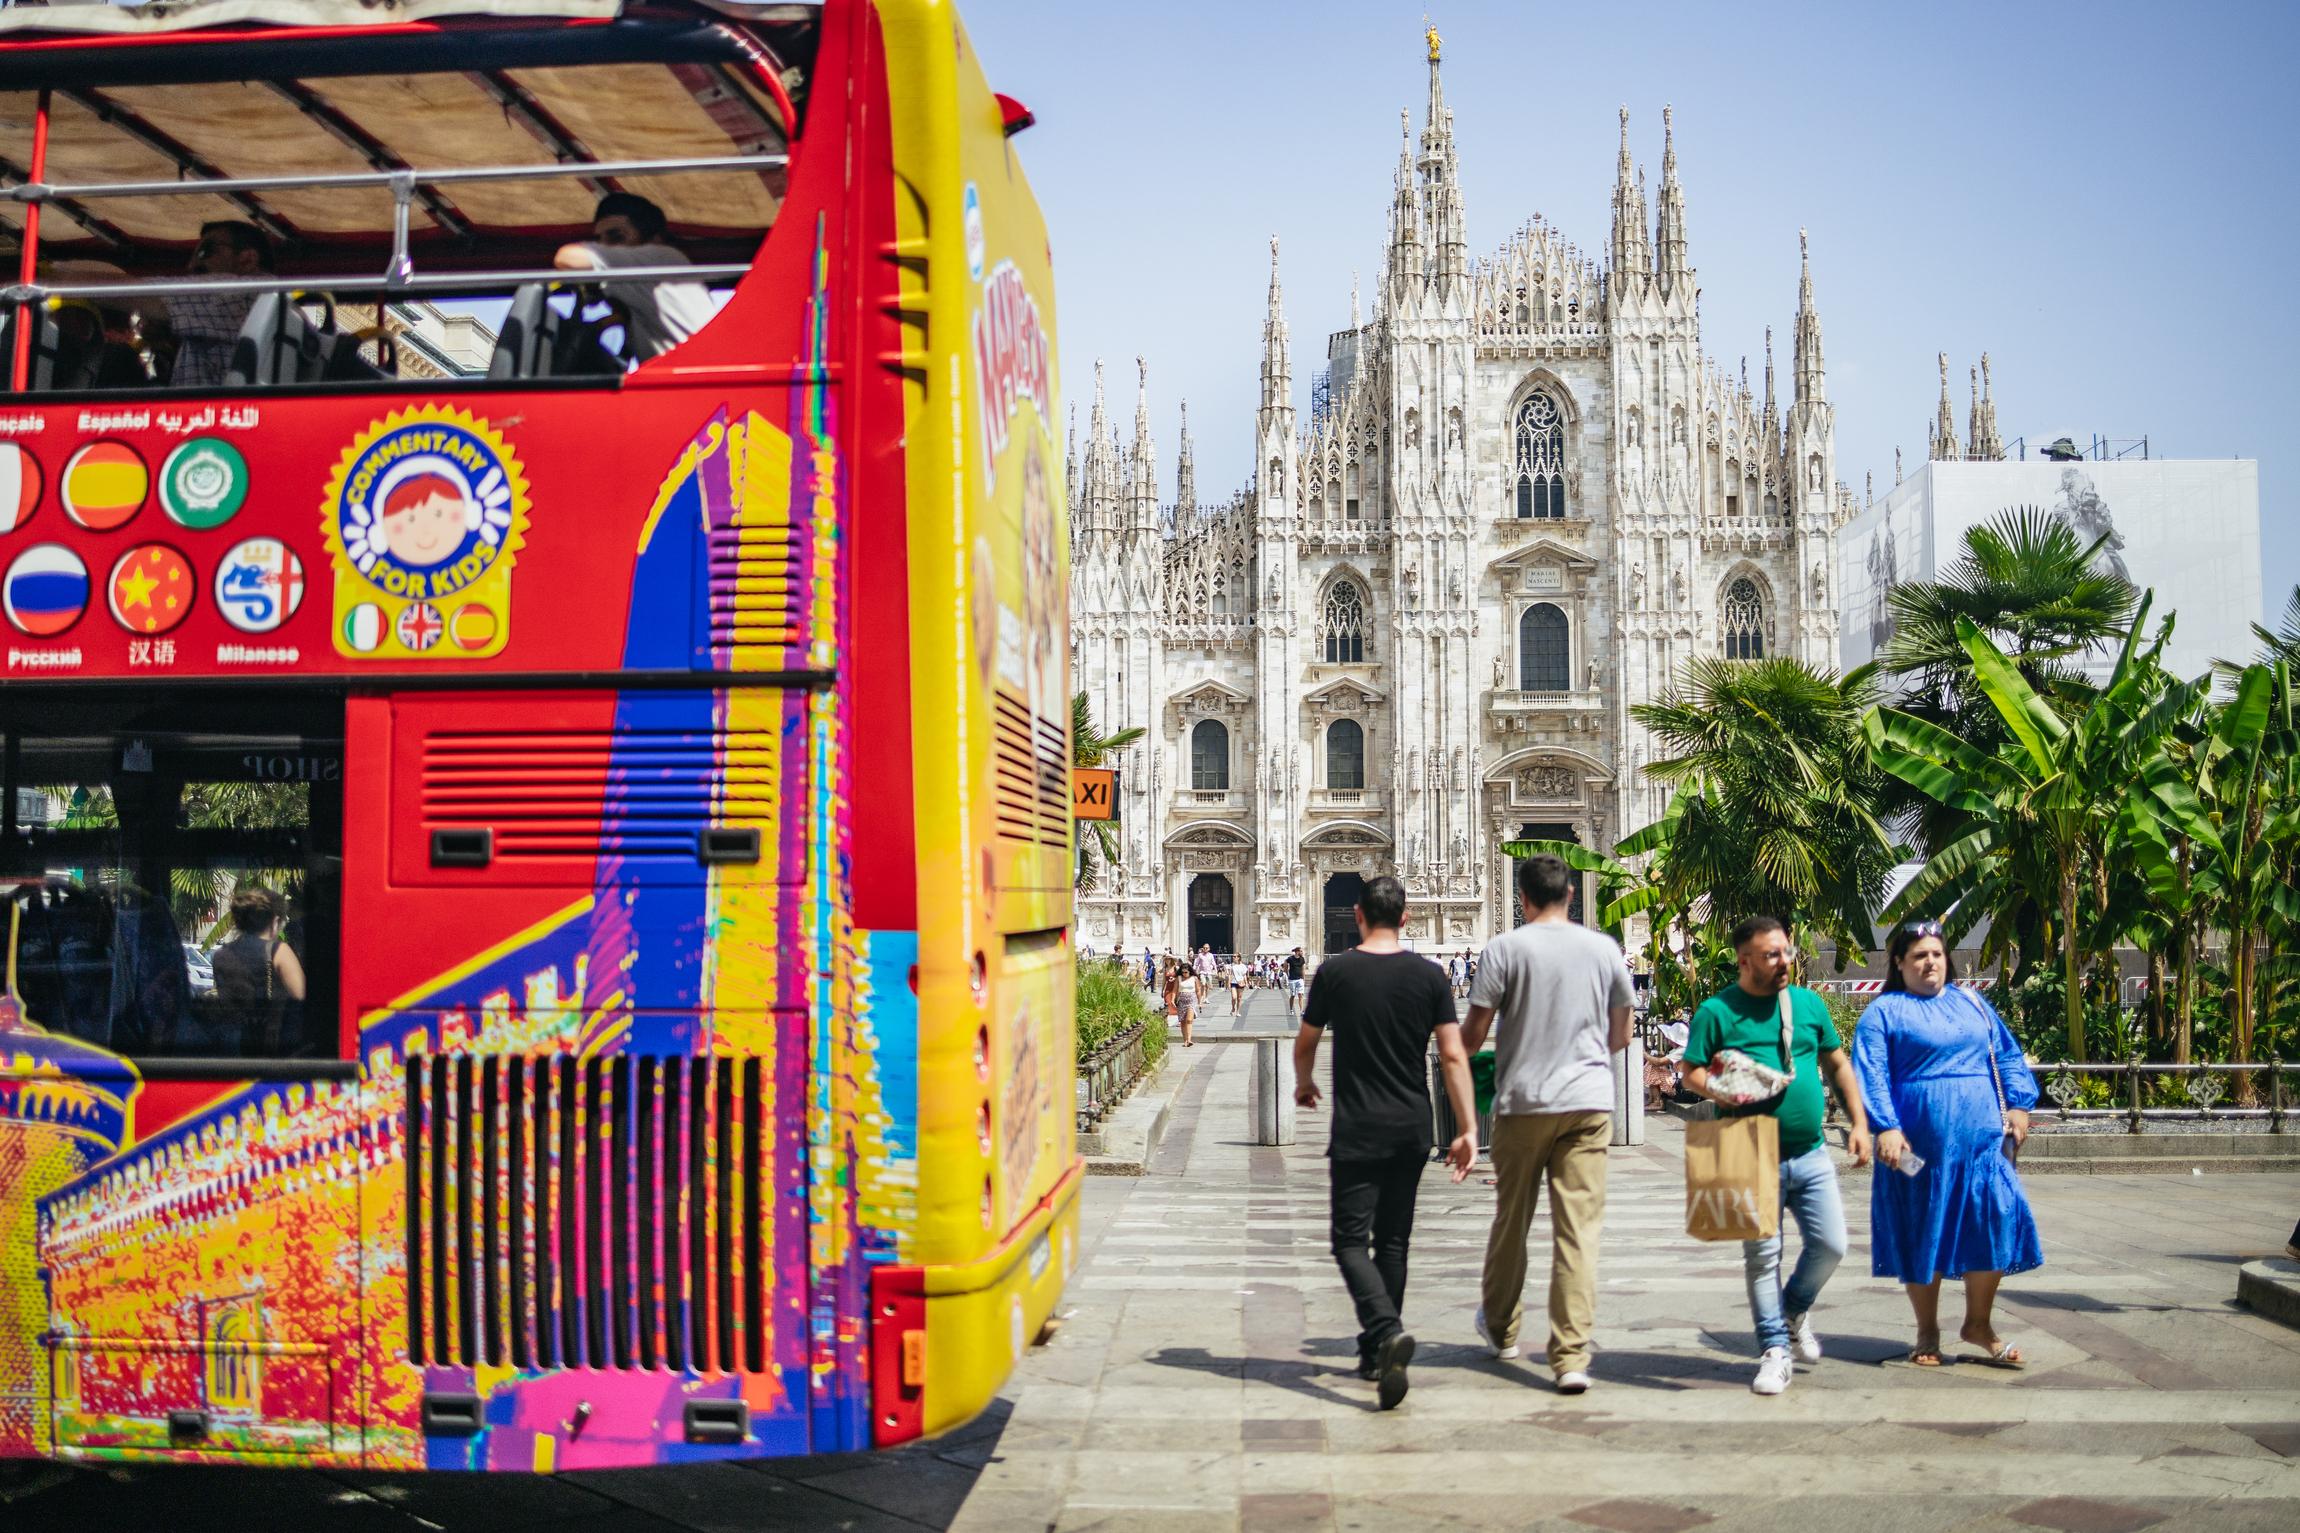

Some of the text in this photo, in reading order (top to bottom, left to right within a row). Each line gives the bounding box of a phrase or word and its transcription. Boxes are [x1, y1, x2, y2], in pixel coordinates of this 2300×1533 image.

[78, 410, 150, 435] Español
[347, 432, 489, 505] COMMENTARY
[369, 540, 497, 598] FOR KIDS
[8, 647, 82, 670] Русский
[128, 638, 176, 665] 汉语
[217, 644, 300, 665] Milanese
